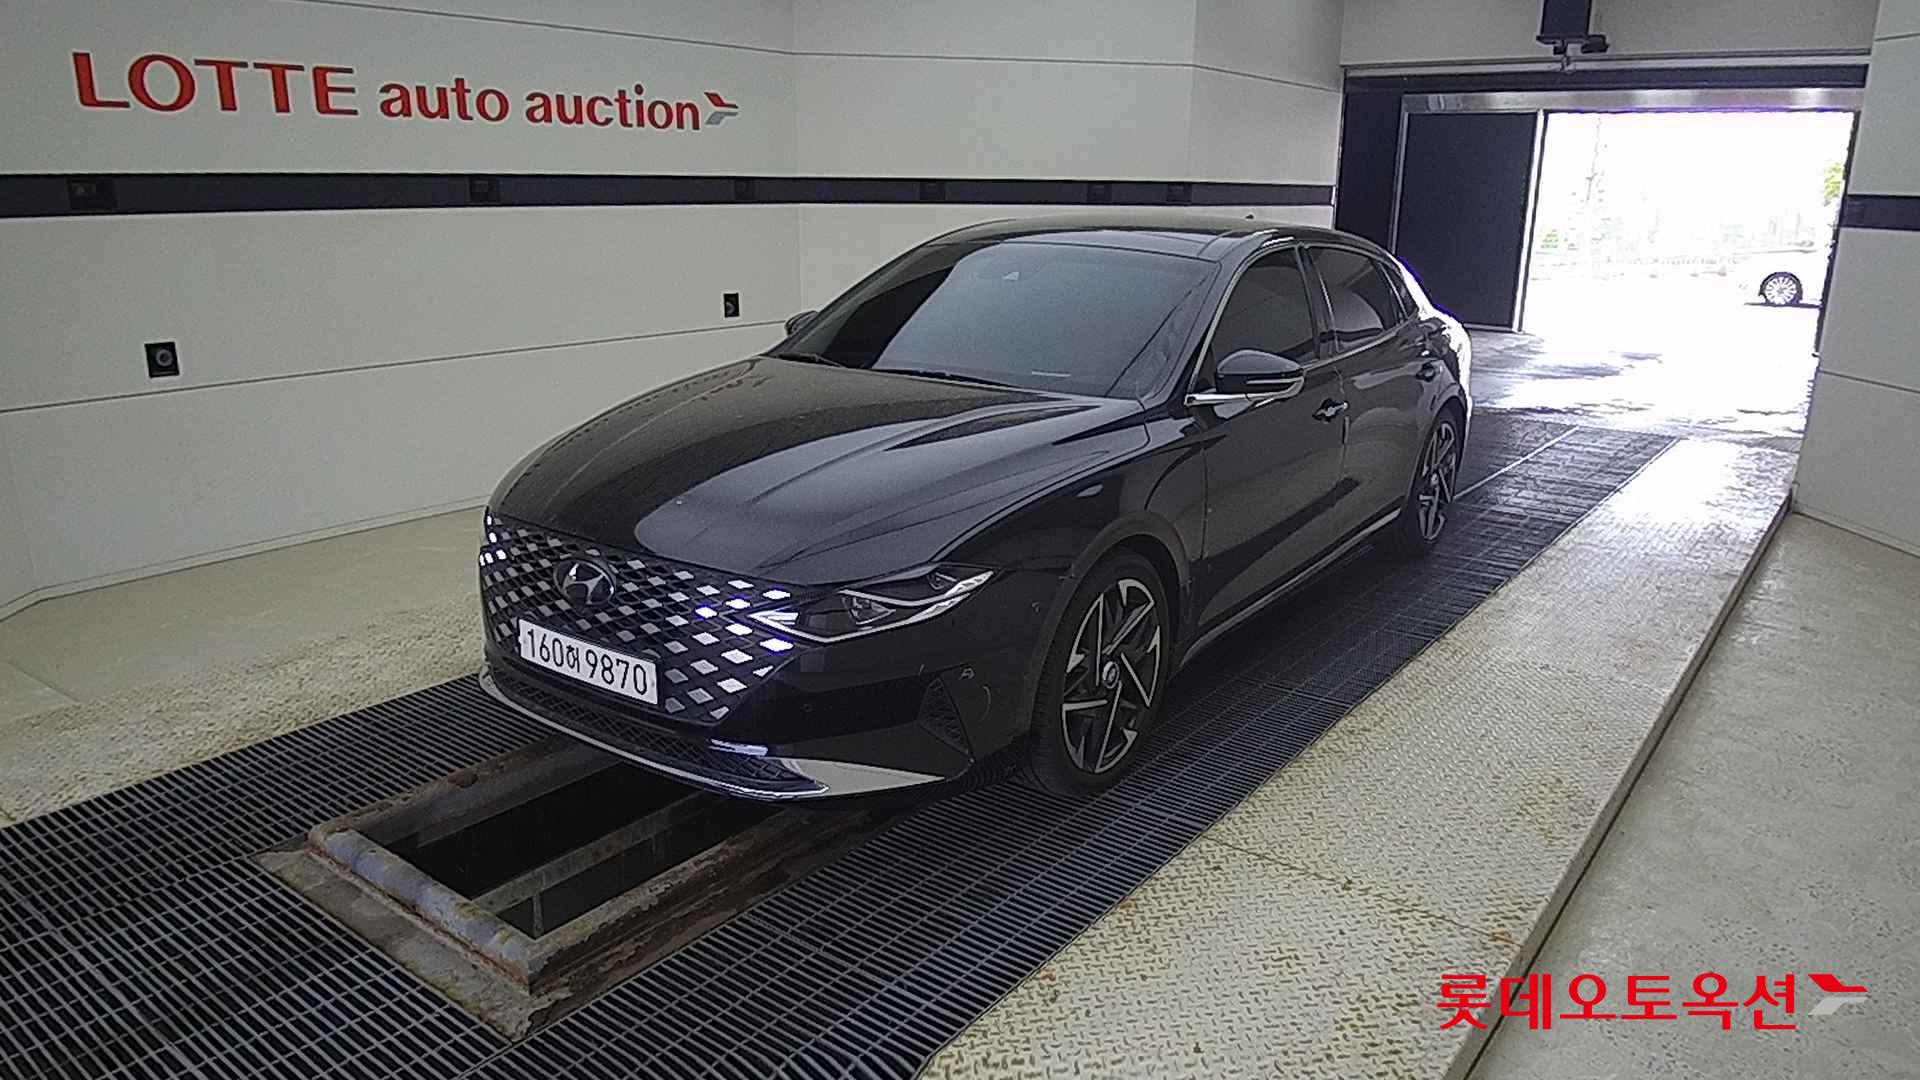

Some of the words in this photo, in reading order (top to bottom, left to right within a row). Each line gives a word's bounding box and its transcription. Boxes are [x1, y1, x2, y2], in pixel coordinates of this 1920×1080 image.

[73, 51, 358, 116] LOTTE
[379, 78, 509, 123] auto
[525, 84, 701, 131] auction
